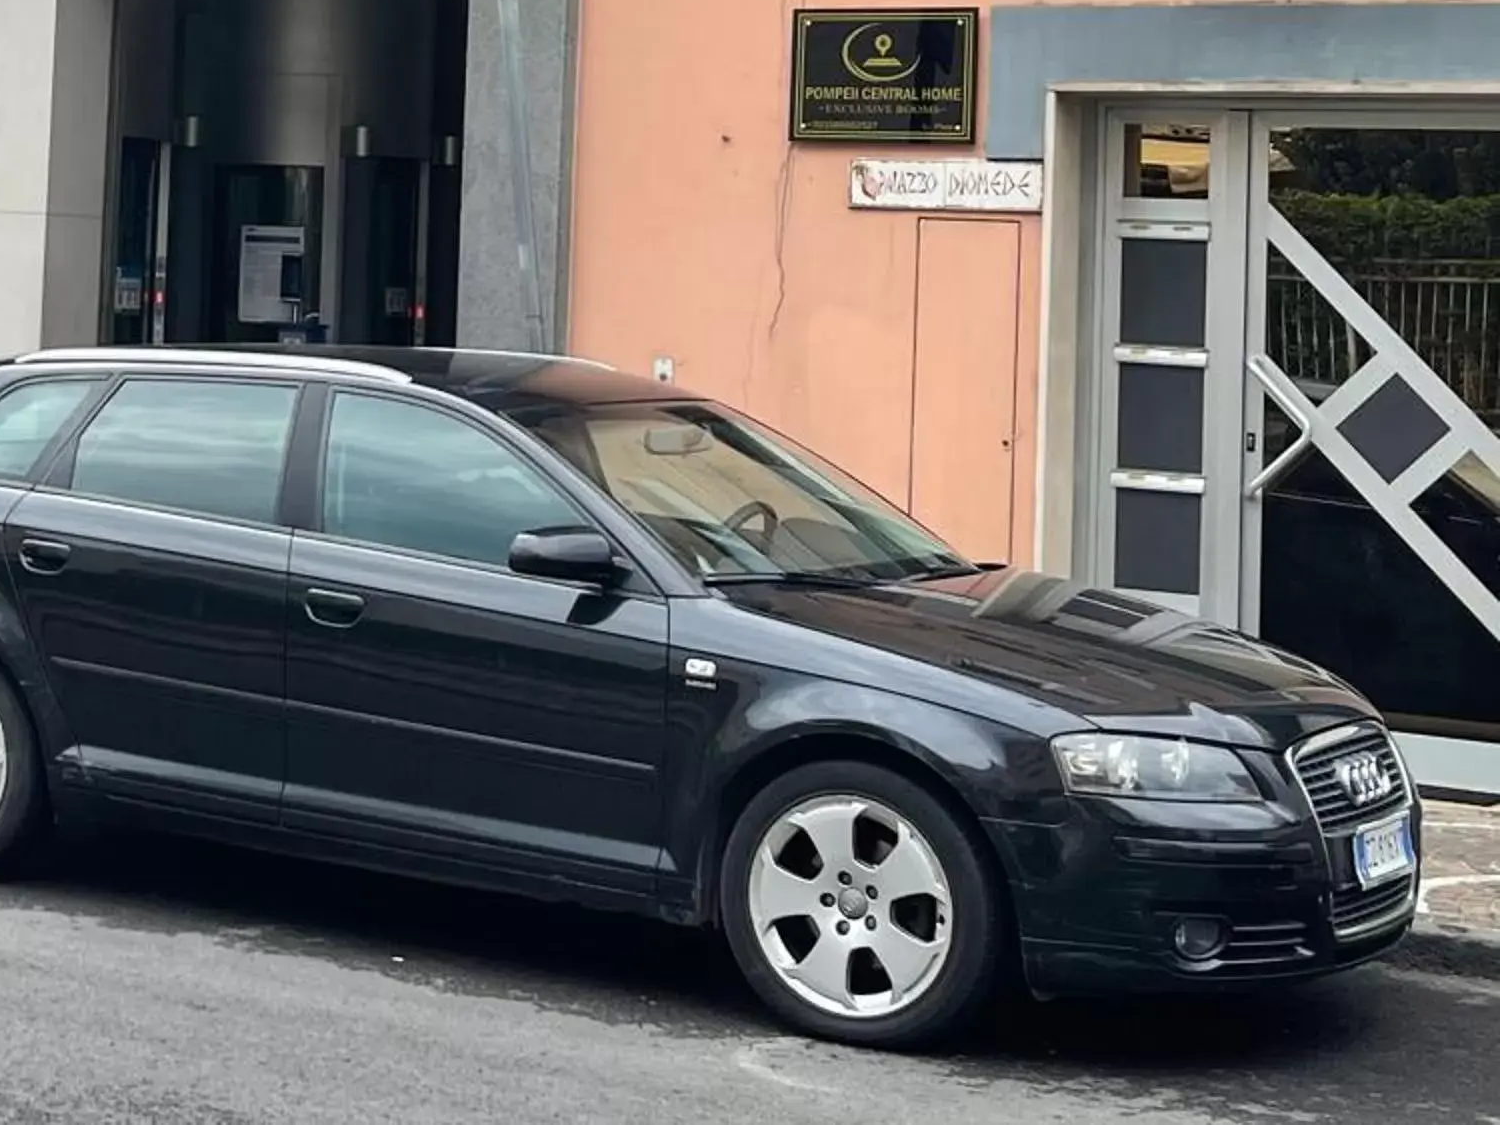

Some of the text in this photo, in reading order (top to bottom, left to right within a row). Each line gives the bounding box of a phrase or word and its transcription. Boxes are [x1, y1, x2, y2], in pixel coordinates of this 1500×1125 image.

[805, 86, 962, 102] POMPEII CENTRAL HOME
[947, 168, 1032, 198] DIOMEDE
